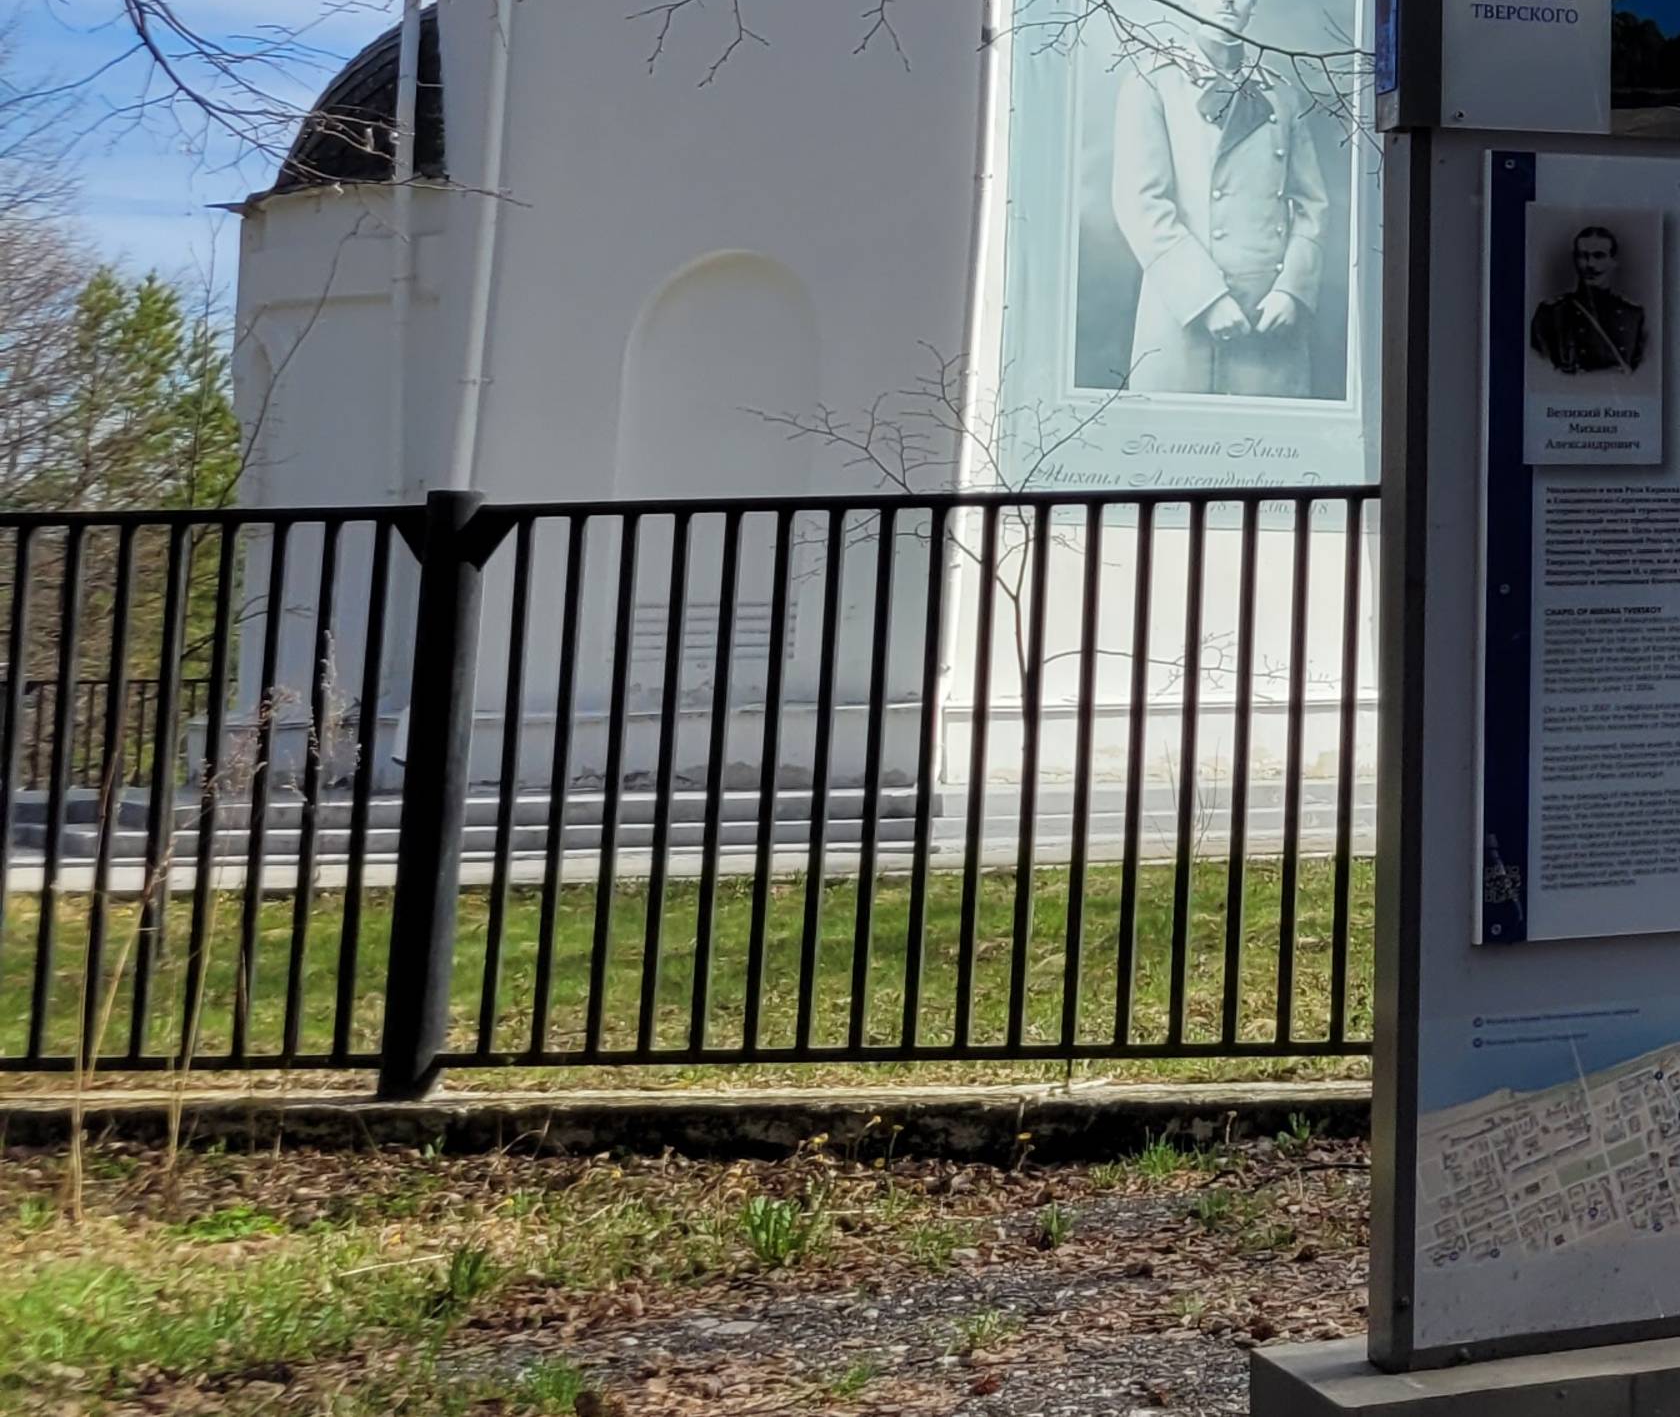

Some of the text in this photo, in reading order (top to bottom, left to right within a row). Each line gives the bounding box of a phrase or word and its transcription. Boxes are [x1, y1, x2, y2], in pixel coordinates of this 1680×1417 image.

[1471, 3, 1578, 25] ТВЕРСКОГО
[1546, 406, 1640, 420] Великий Князь
[1121, 434, 1300, 459] Великий Князь
